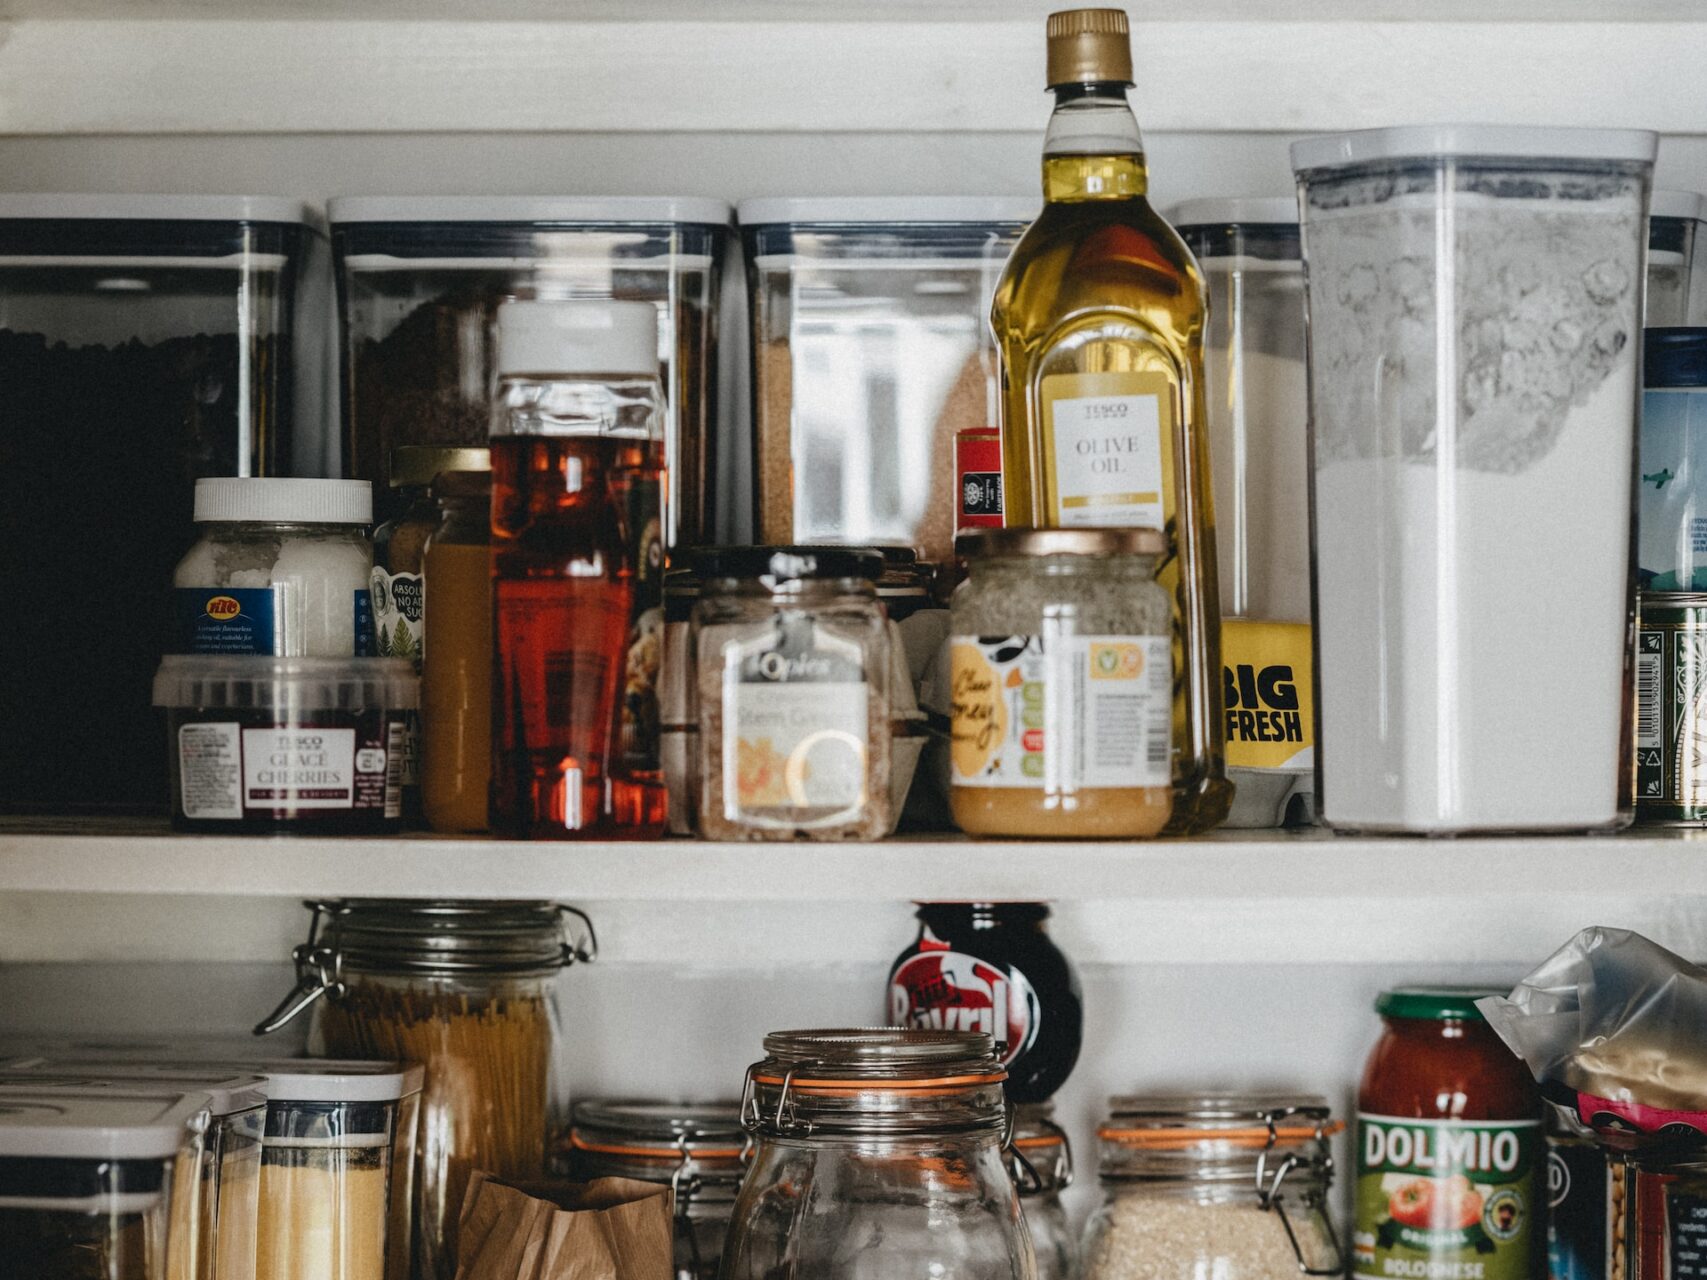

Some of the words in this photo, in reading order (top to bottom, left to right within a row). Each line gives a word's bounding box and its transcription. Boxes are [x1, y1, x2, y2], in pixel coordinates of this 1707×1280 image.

[1085, 403, 1128, 414] TESCO
[1076, 436, 1139, 455] OLIVE
[1091, 457, 1127, 473] OIL
[397, 596, 411, 607] NO
[1224, 664, 1299, 710] BIG
[1226, 710, 1303, 742] FRESH
[257, 770, 341, 784] CHERRIES
[1365, 1124, 1520, 1173] DOLMIO
[1401, 1230, 1469, 1245] ORIGINAL
[1383, 1258, 1485, 1280] BOLOGNESE
